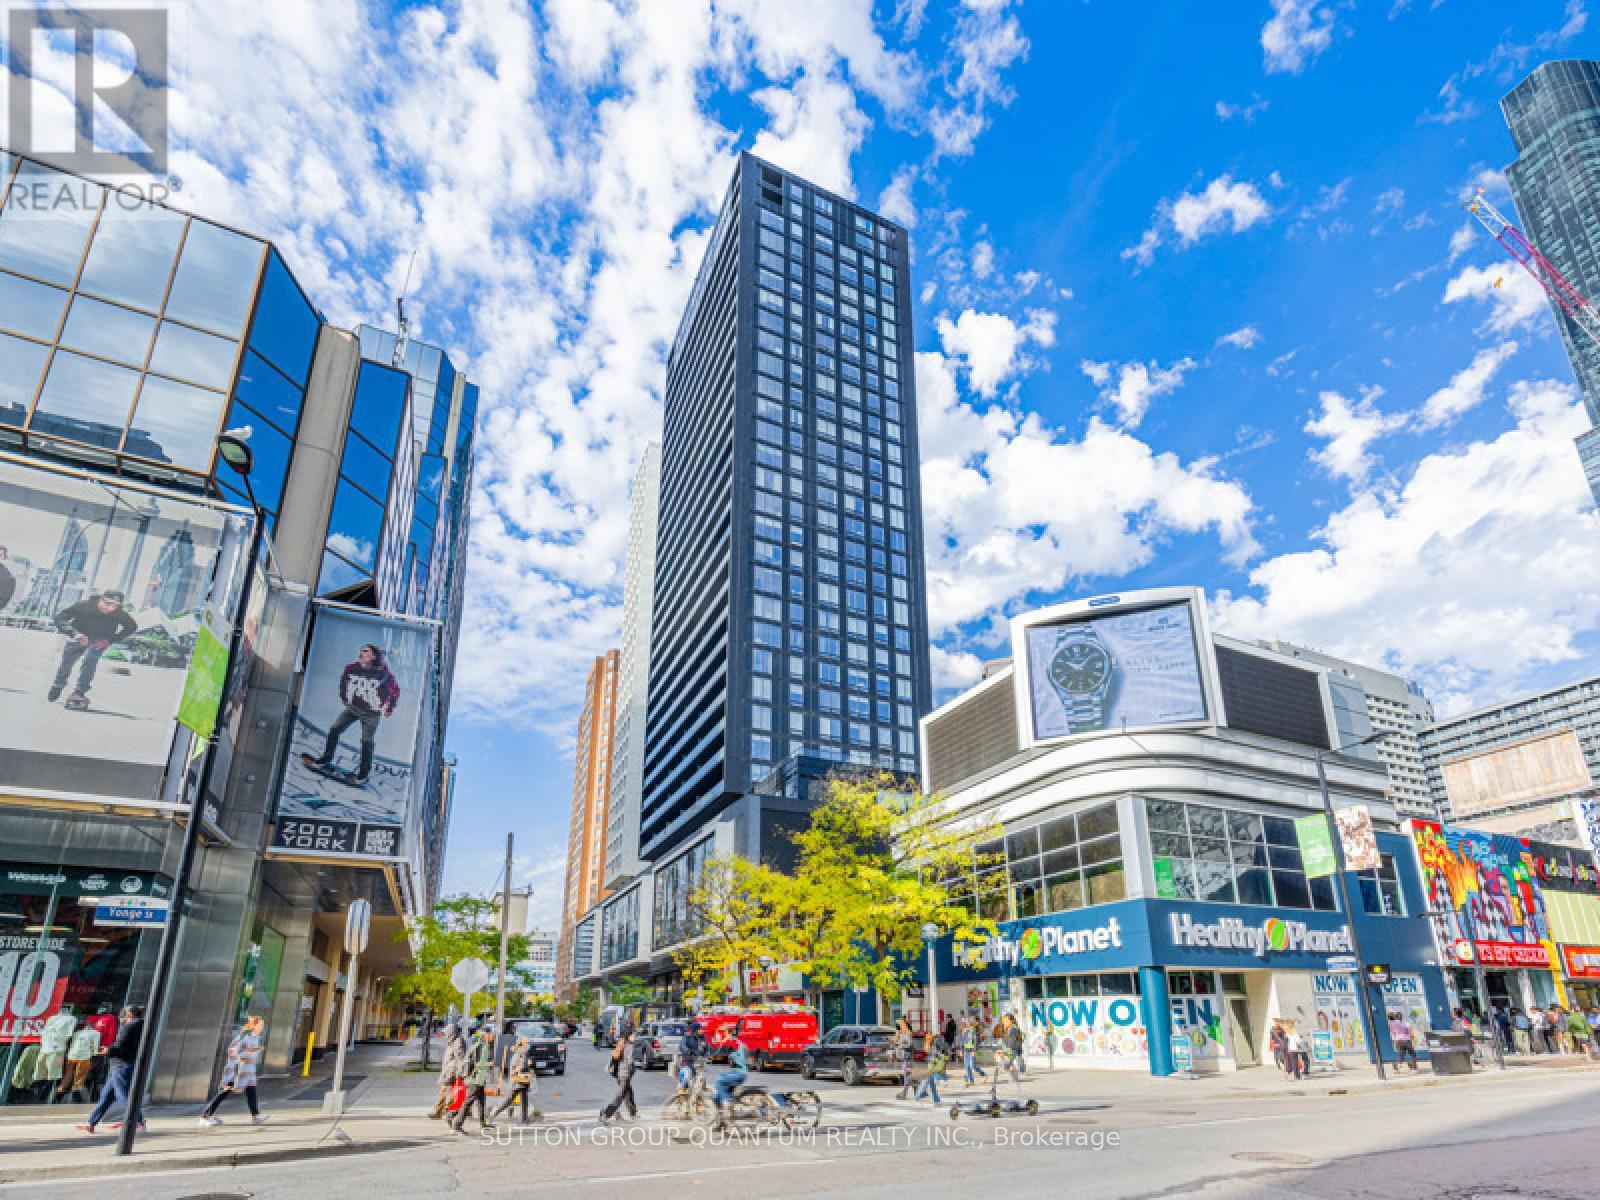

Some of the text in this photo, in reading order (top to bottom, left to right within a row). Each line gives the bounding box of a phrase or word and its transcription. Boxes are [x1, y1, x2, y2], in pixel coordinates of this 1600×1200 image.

[283, 821, 333, 837] ZOO
[281, 835, 347, 852] YORK
[1041, 917, 1123, 957] Planet
[1168, 911, 1355, 957] Healthy Planet
[1031, 1000, 1097, 1027] NOW
